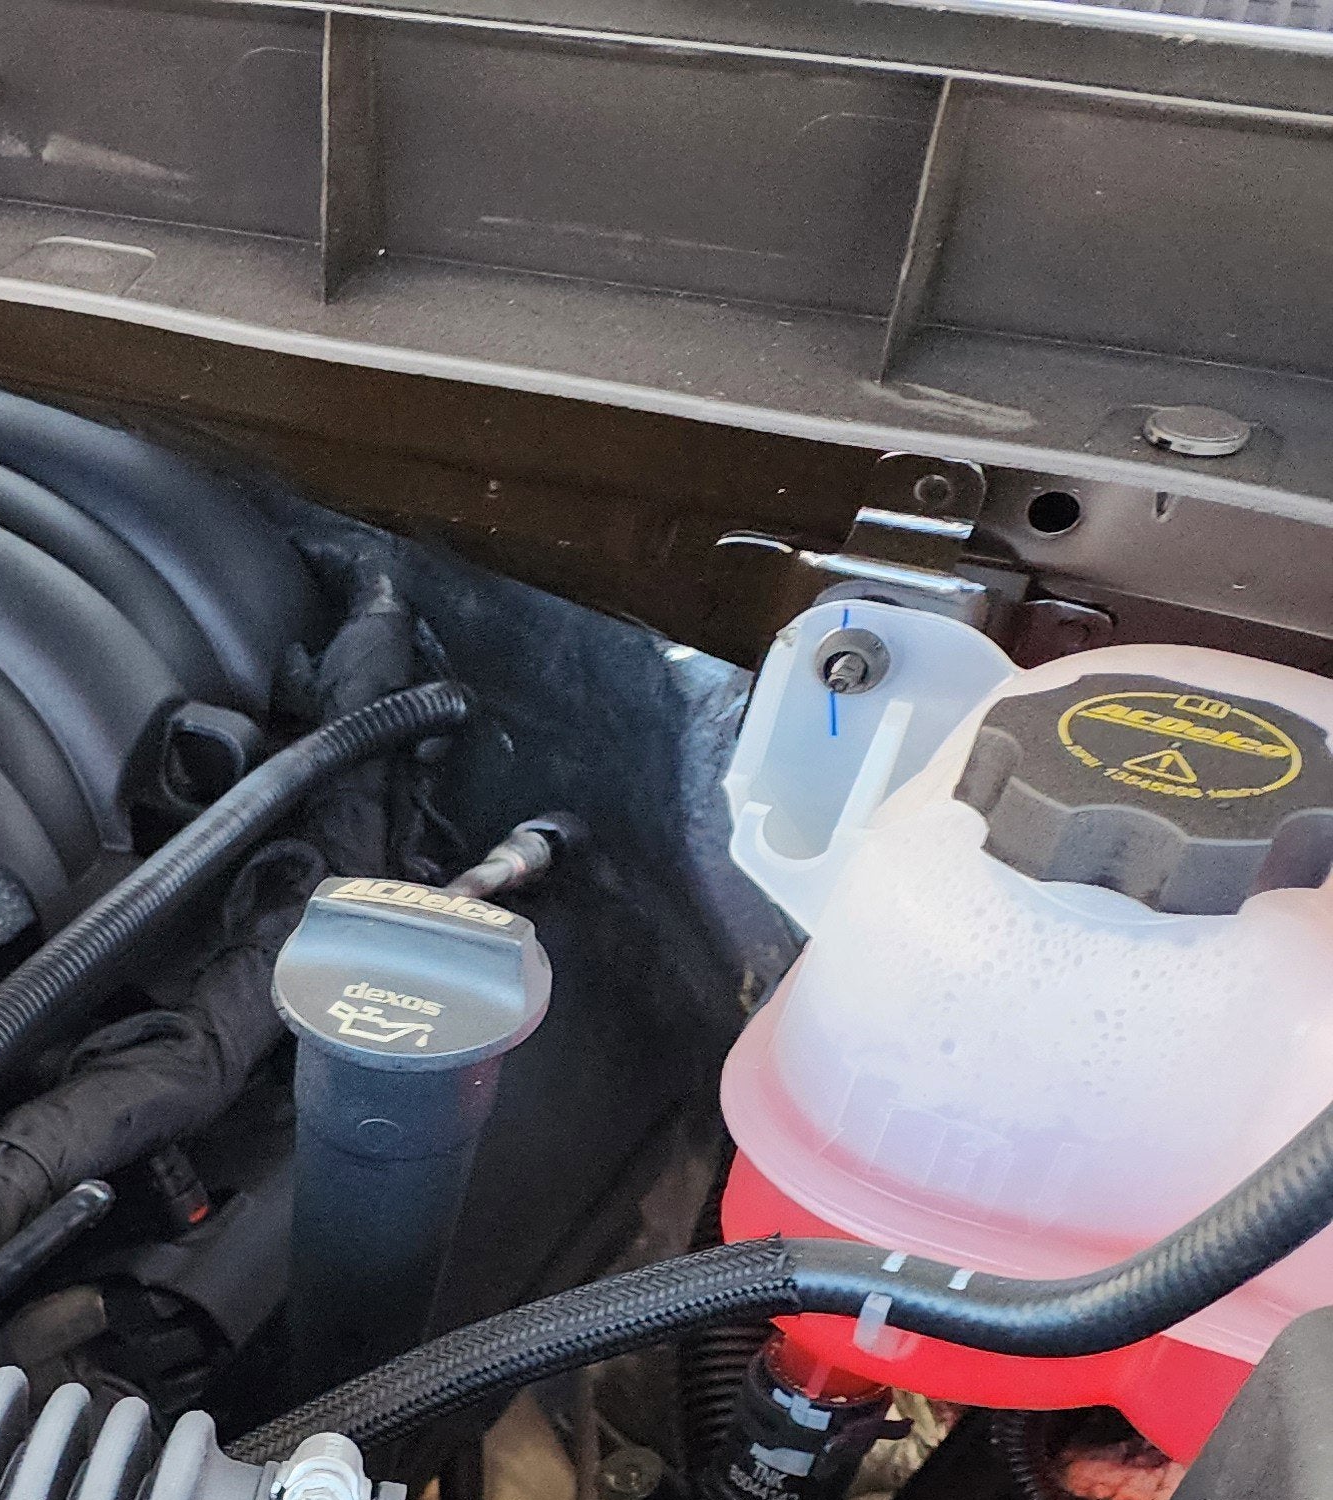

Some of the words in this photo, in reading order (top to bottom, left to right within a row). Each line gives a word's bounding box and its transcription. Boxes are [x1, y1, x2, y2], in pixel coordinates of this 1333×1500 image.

[1077, 703, 1291, 757] ACDelco
[329, 879, 513, 927] ACDelco
[343, 982, 446, 1017] dexos
